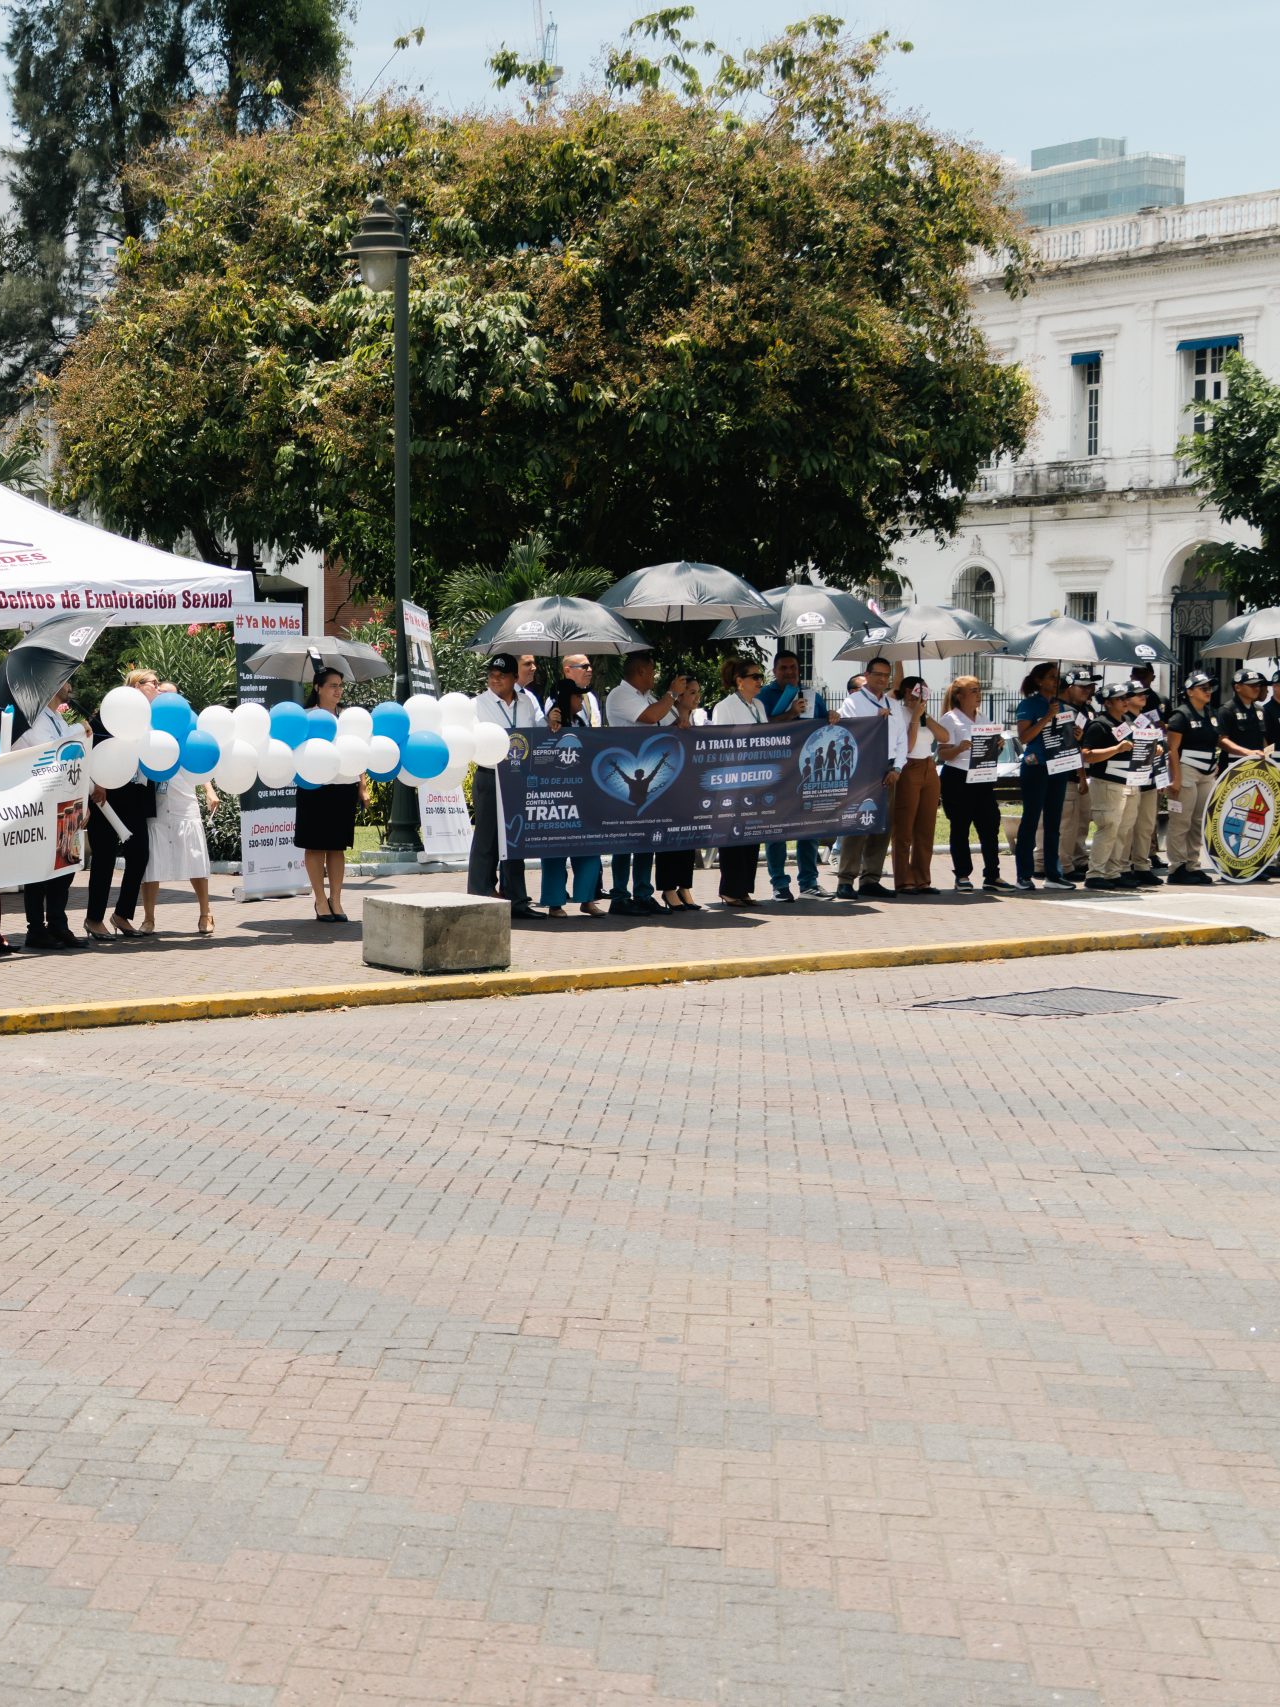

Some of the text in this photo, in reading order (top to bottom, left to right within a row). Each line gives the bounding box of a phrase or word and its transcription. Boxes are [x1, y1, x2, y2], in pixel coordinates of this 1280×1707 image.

[62, 590, 80, 608] de
[84, 589, 176, 608] Explotación
[182, 590, 232, 608] Sexual
[262, 616, 276, 628] No
[280, 615, 300, 629] Más
[696, 736, 791, 750] LA TRATA DE PERSONAS
[692, 749, 792, 764] NO ES UNA OPORTUNIDAD
[31, 764, 68, 776] SEPROVIT
[710, 770, 772, 785] ES UN DELITO
[1230, 769, 1279, 797] POLICIA NACIONAL
[803, 781, 848, 790] SEPTIEMBRE
[526, 790, 539, 799] DÍA
[525, 805, 579, 820] TRATA
[538, 821, 582, 829] PERSONAS
[2, 827, 47, 847] VENDEN.
[249, 840, 273, 848] 520-1050
